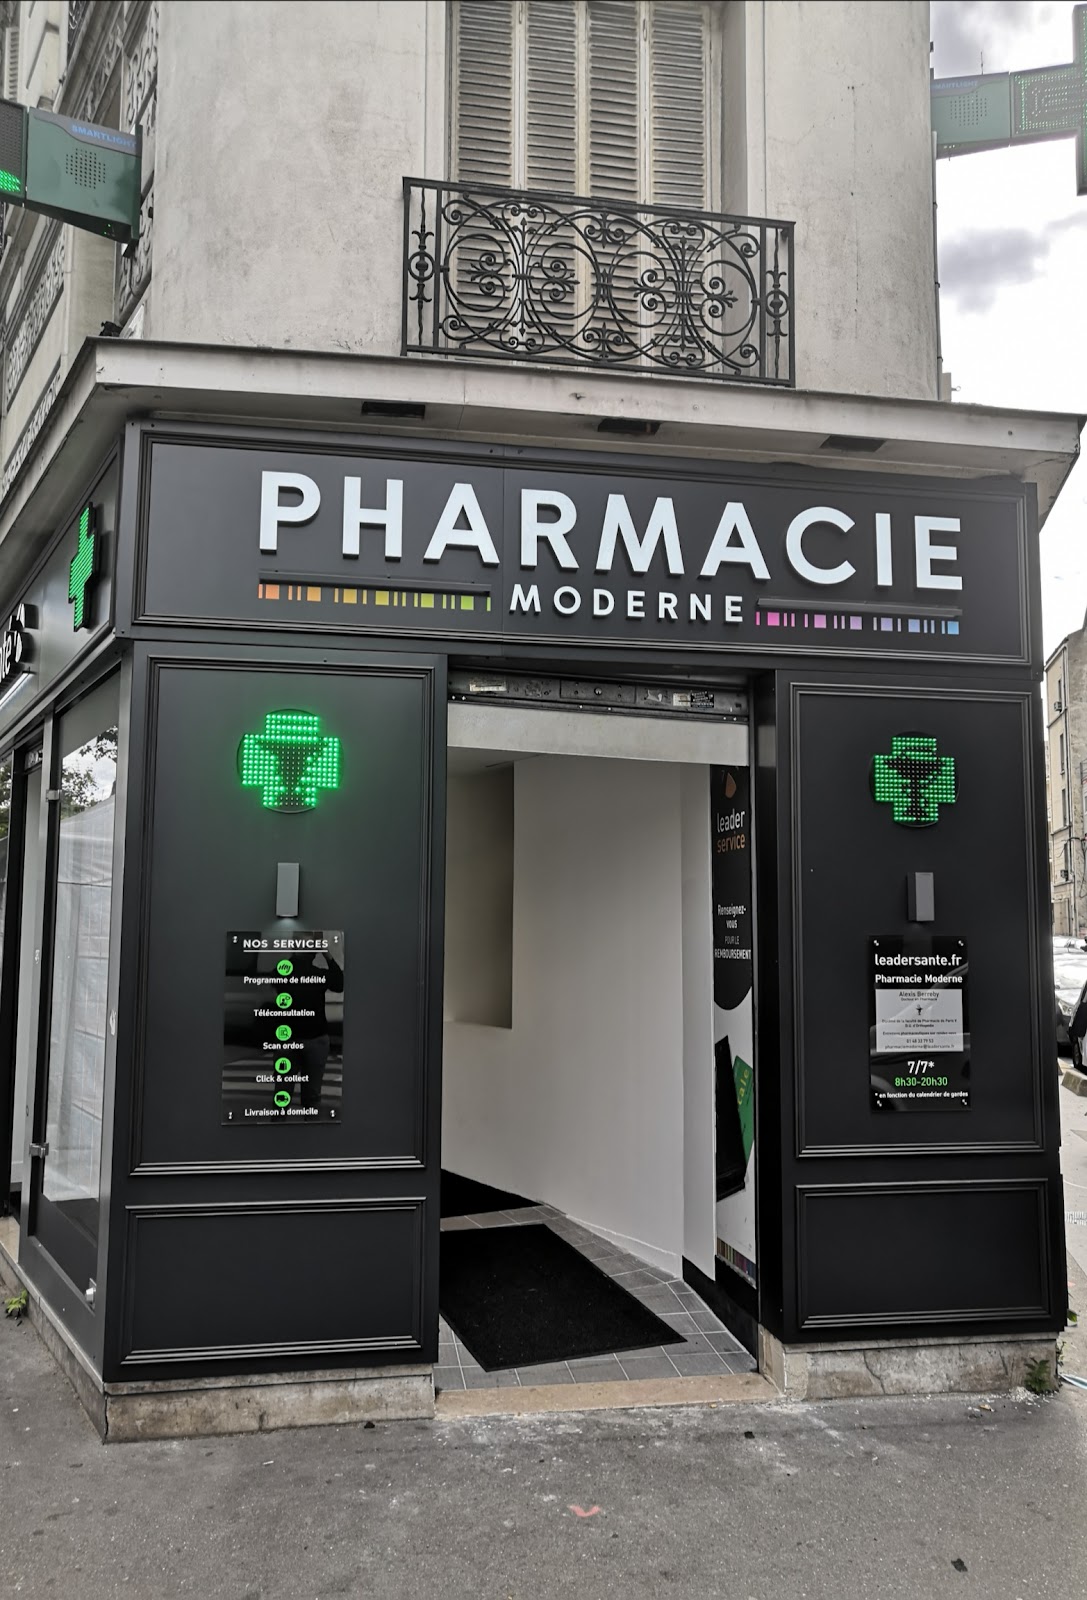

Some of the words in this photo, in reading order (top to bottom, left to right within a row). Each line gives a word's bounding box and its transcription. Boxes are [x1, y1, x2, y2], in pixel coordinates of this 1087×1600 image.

[72, 124, 136, 148] SMARTLIGHT
[259, 471, 963, 590] PHARMACIE
[508, 583, 743, 623] MODERNE
[717, 808, 745, 833] leader
[717, 831, 746, 853] service
[243, 939, 268, 948] NOS
[273, 939, 328, 948] SERVICES
[714, 948, 751, 960] REMBOURSEMENT
[874, 953, 962, 966] leadersante.fr
[243, 976, 288, 986] Programme
[289, 976, 299, 984] de
[300, 975, 326, 984] fidélité
[875, 974, 922, 983] Pharmacie
[924, 974, 963, 983] Moderne
[253, 1009, 315, 1017] Téléconsultation
[263, 1042, 281, 1050] Scan
[283, 1042, 304, 1050] ordos
[256, 1075, 275, 1083] Click
[284, 1075, 309, 1083] collect
[894, 1077, 948, 1087] 8h30-20h30
[244, 1108, 279, 1117] Livraison
[280, 1107, 286, 1116] à
[289, 1107, 318, 1116] domicile
